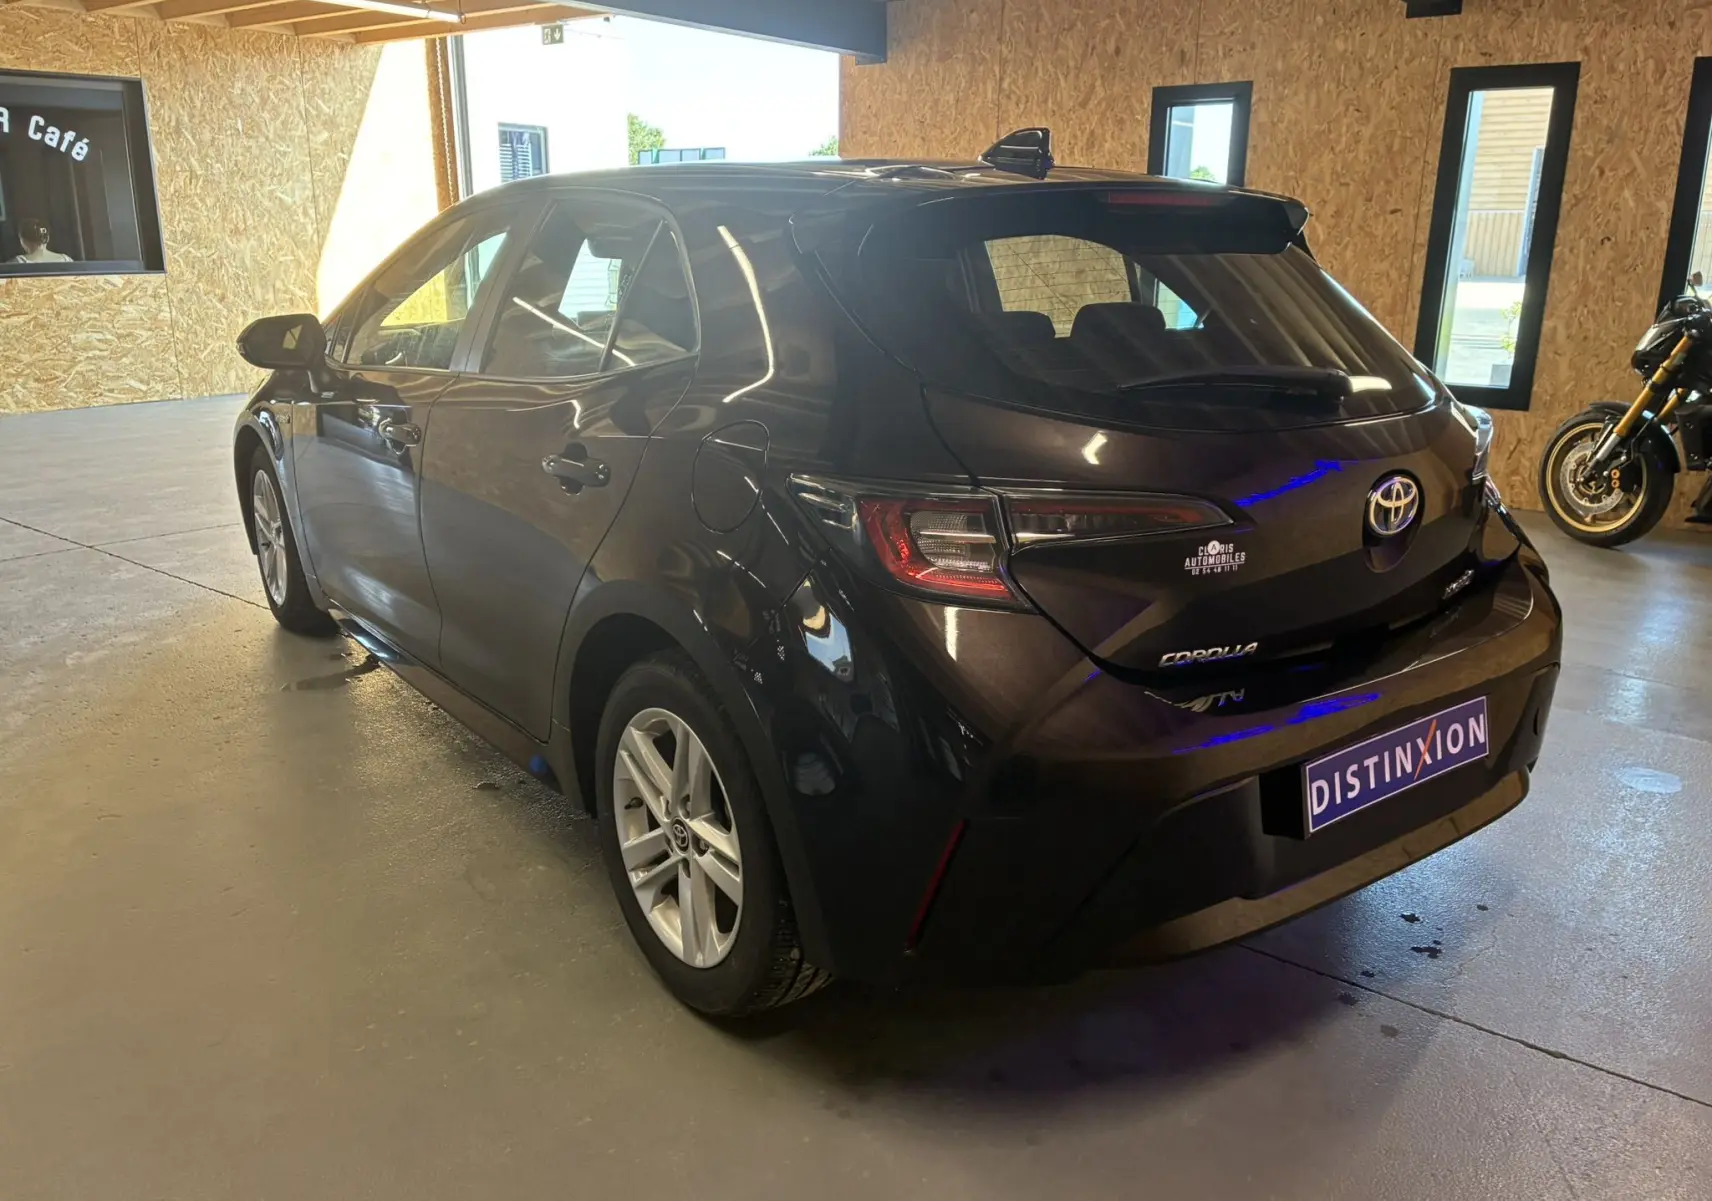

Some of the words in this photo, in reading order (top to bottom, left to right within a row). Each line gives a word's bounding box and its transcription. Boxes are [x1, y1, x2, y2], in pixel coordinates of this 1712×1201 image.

[28, 115, 90, 161] Café
[1184, 552, 1246, 567] AUTOMOBILES
[1198, 540, 1234, 556] CLARIS
[1158, 642, 1258, 667] COROLLA
[1311, 714, 1486, 816] DISTINXION
